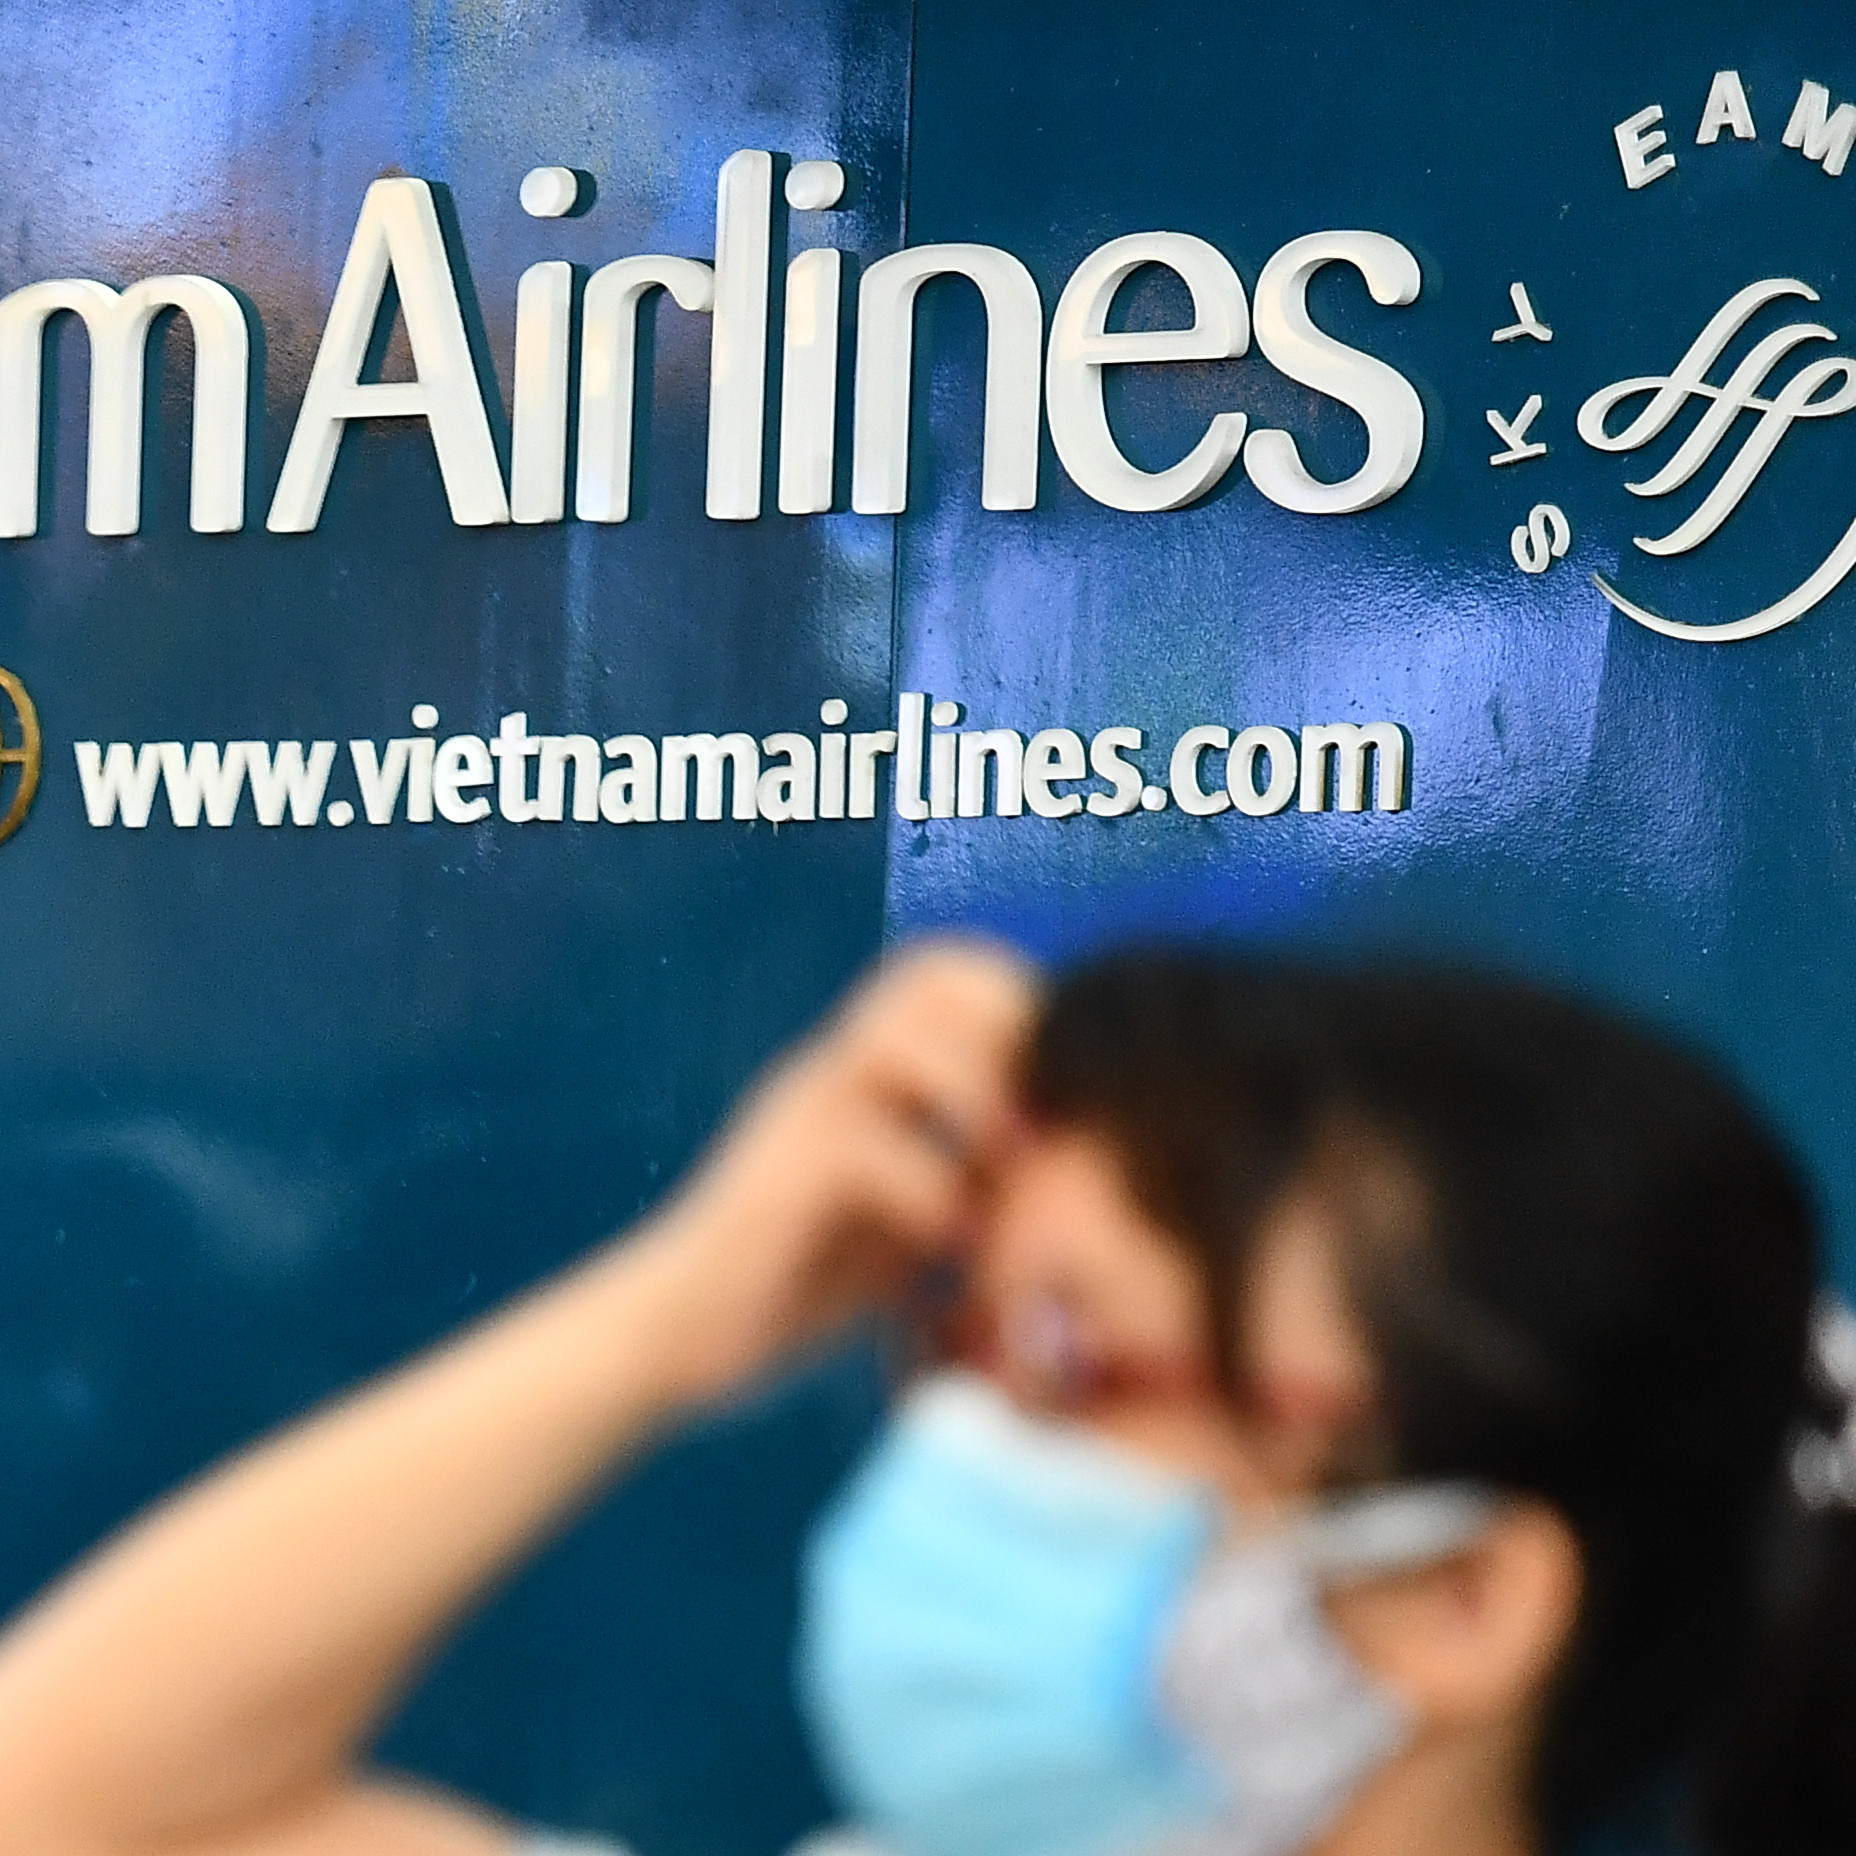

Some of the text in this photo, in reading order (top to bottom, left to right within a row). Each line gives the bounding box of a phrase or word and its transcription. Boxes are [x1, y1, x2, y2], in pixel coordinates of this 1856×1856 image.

[265, 147, 1424, 529] Airlines
[1486, 281, 1571, 573] SKY
[73, 691, 1409, 828] www.vietnamairlines.com
